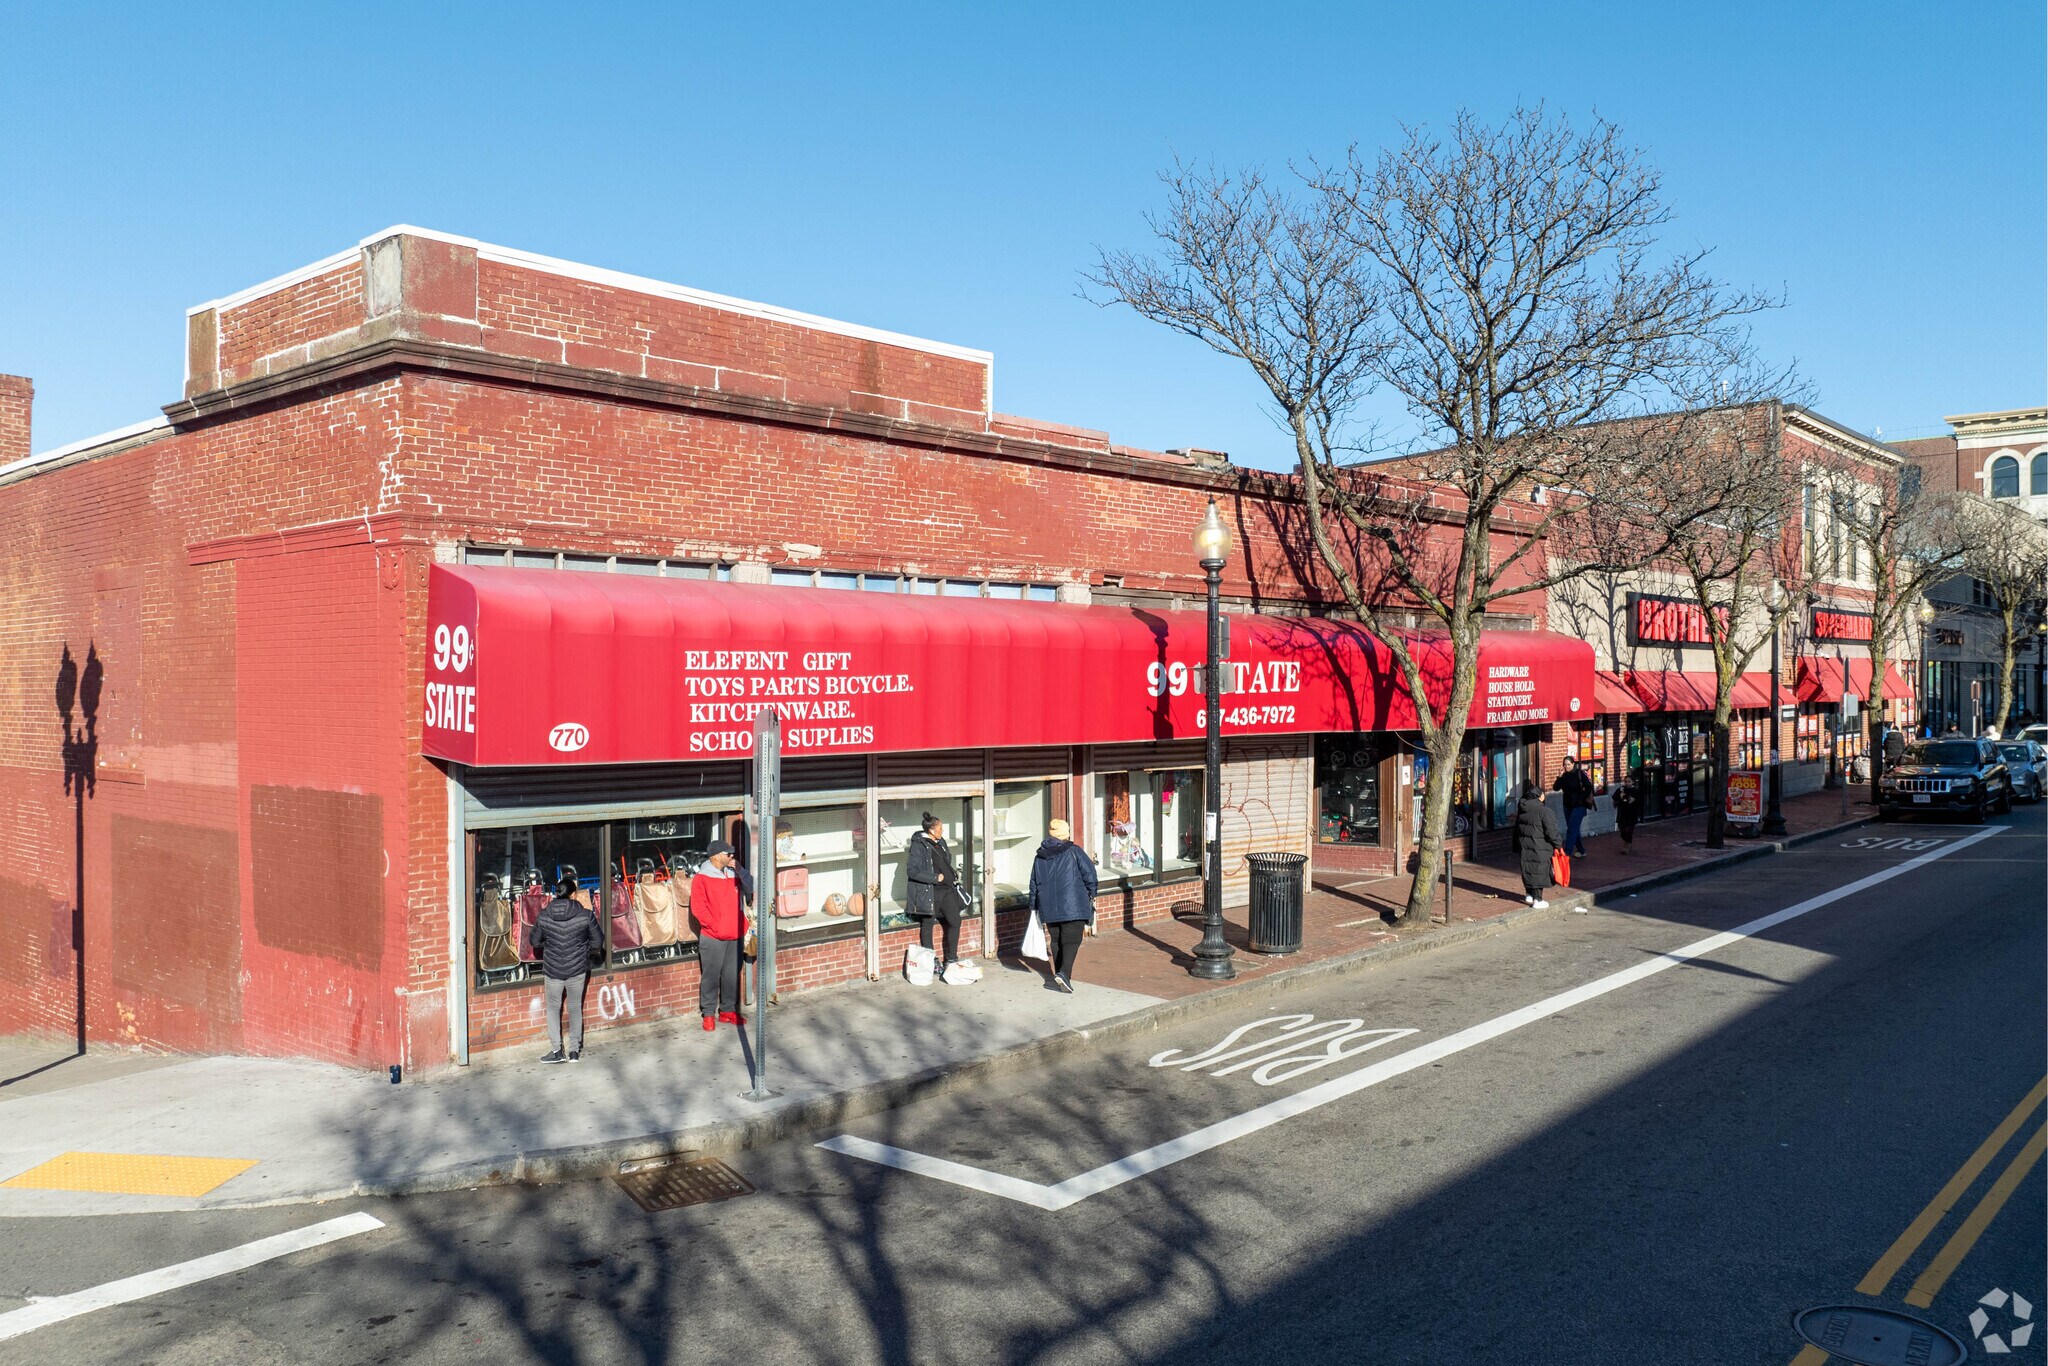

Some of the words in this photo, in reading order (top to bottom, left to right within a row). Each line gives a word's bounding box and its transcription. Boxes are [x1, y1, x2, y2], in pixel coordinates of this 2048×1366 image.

[1639, 599, 1729, 644] BROTHES
[685, 651, 788, 671] ELEFENT
[803, 652, 851, 671] GIFT
[1219, 661, 1300, 695] TATE
[1489, 666, 1530, 679] HARDWARE
[685, 677, 744, 697] TOYS
[750, 676, 820, 696] PARTS
[825, 674, 914, 695] BICYCLE.
[1488, 681, 1514, 694] HOUSE
[1514, 681, 1535, 692] HOLD.
[425, 682, 476, 734] STATE
[1487, 694, 1533, 708] STATIONERY.
[1196, 705, 1295, 729] 67-436-7972
[1487, 710, 1512, 724] FRAME
[1512, 709, 1528, 722] AND
[1528, 708, 1549, 720] MORE
[553, 728, 585, 747] 770
[690, 731, 782, 752] SCHO
[788, 726, 874, 748] SUPLIES
[1840, 837, 1946, 851] BUS
[1148, 1013, 1421, 1086] BUS
